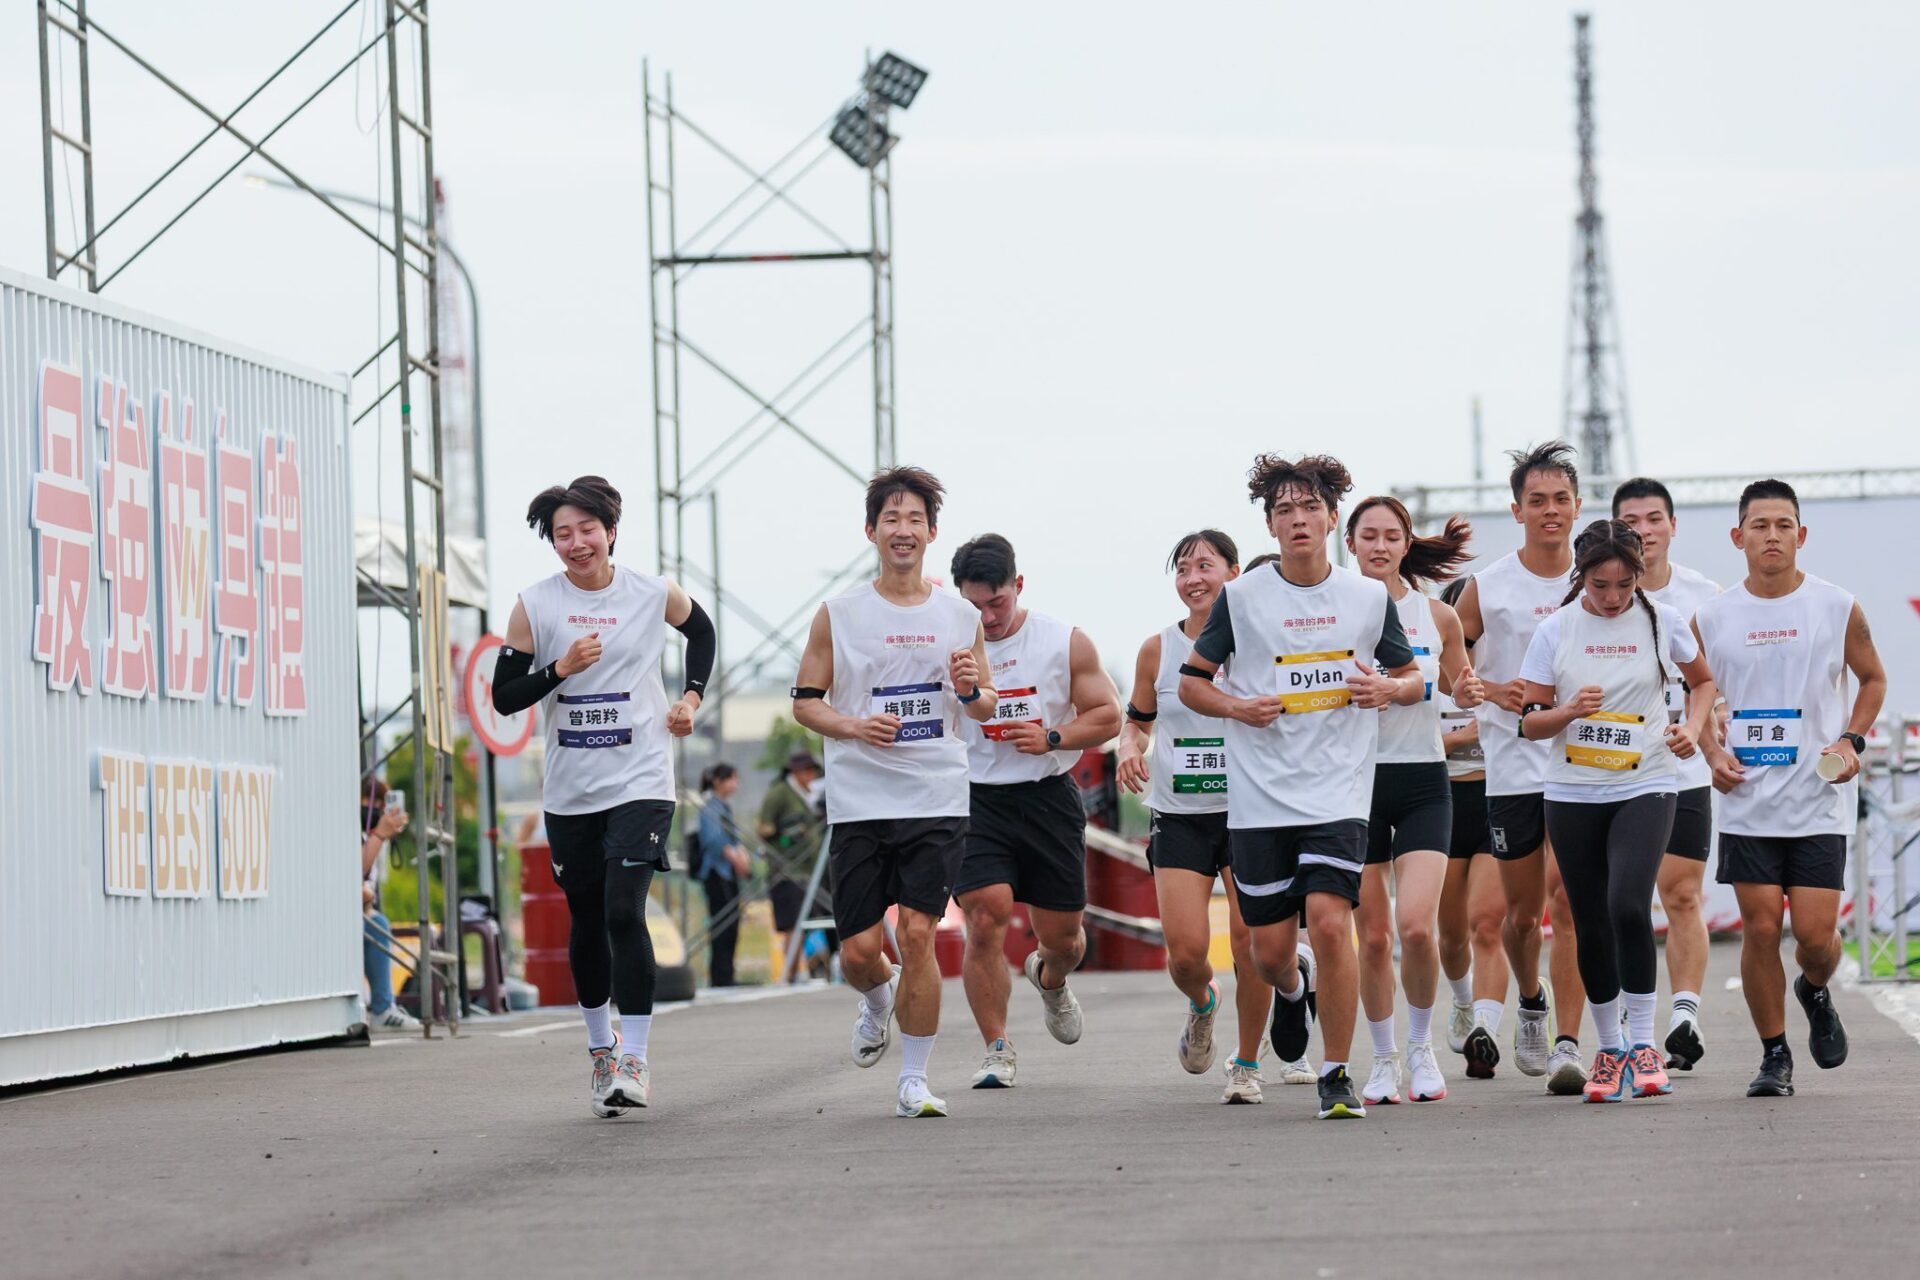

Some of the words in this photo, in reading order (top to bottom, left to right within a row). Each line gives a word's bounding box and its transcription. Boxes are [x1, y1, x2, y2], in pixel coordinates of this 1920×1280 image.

[1290, 669, 1343, 689] Dylan
[884, 699, 931, 717] 梅賢治
[1311, 696, 1341, 707] 0001
[569, 708, 619, 725] 曾琬羚
[993, 702, 1029, 719] 威杰
[586, 735, 619, 745] 0001
[901, 727, 931, 737] 0001
[1578, 725, 1631, 746] 梁舒涵
[1594, 755, 1627, 766] 0001
[1760, 753, 1790, 762] 0001
[101, 756, 146, 890] THE
[154, 764, 213, 893] BEST
[220, 769, 273, 894] BODY
